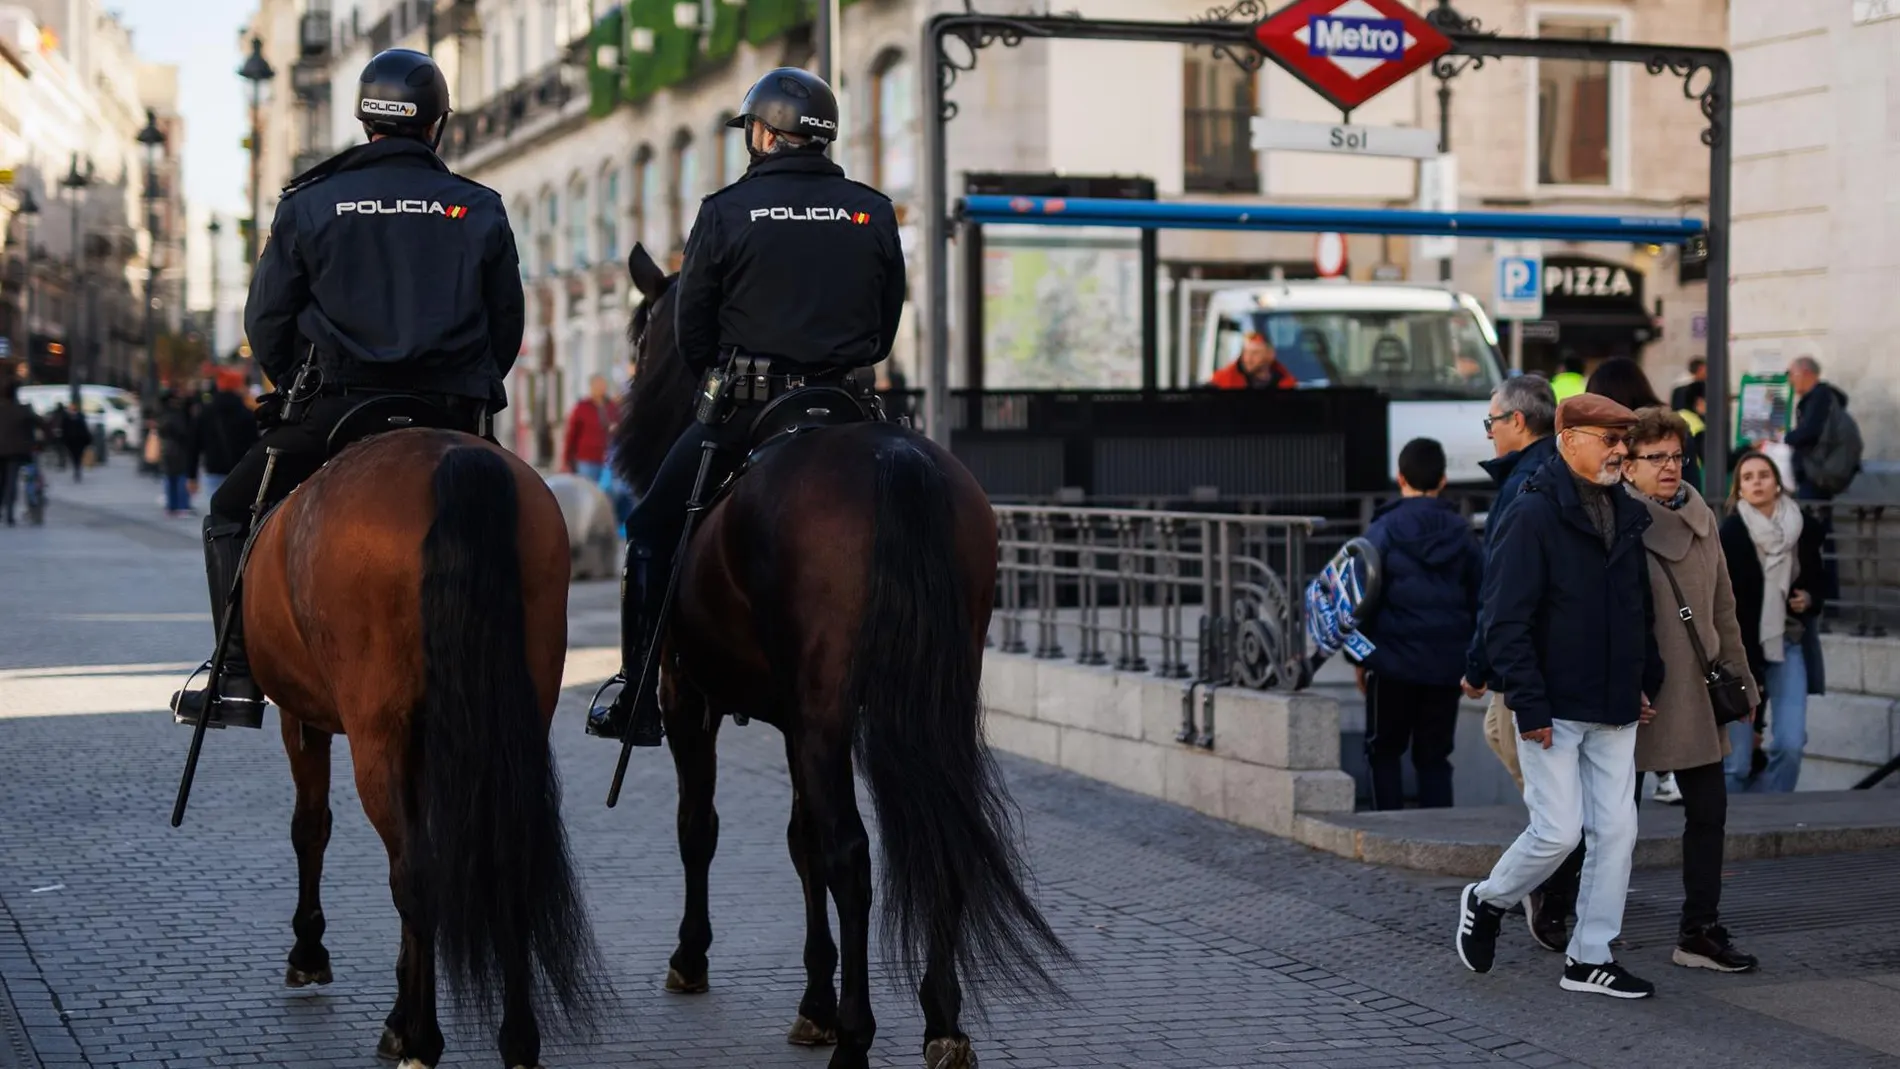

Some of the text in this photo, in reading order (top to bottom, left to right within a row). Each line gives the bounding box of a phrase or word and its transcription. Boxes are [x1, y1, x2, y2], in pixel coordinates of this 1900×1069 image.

[1316, 19, 1399, 53] Metro
[362, 101, 406, 114] POLICIA
[1330, 127, 1367, 149] Sol
[336, 199, 446, 215] POLICIA
[750, 206, 852, 222] POLICIA
[1505, 262, 1530, 296] P
[1545, 265, 1633, 296] PIZZA
